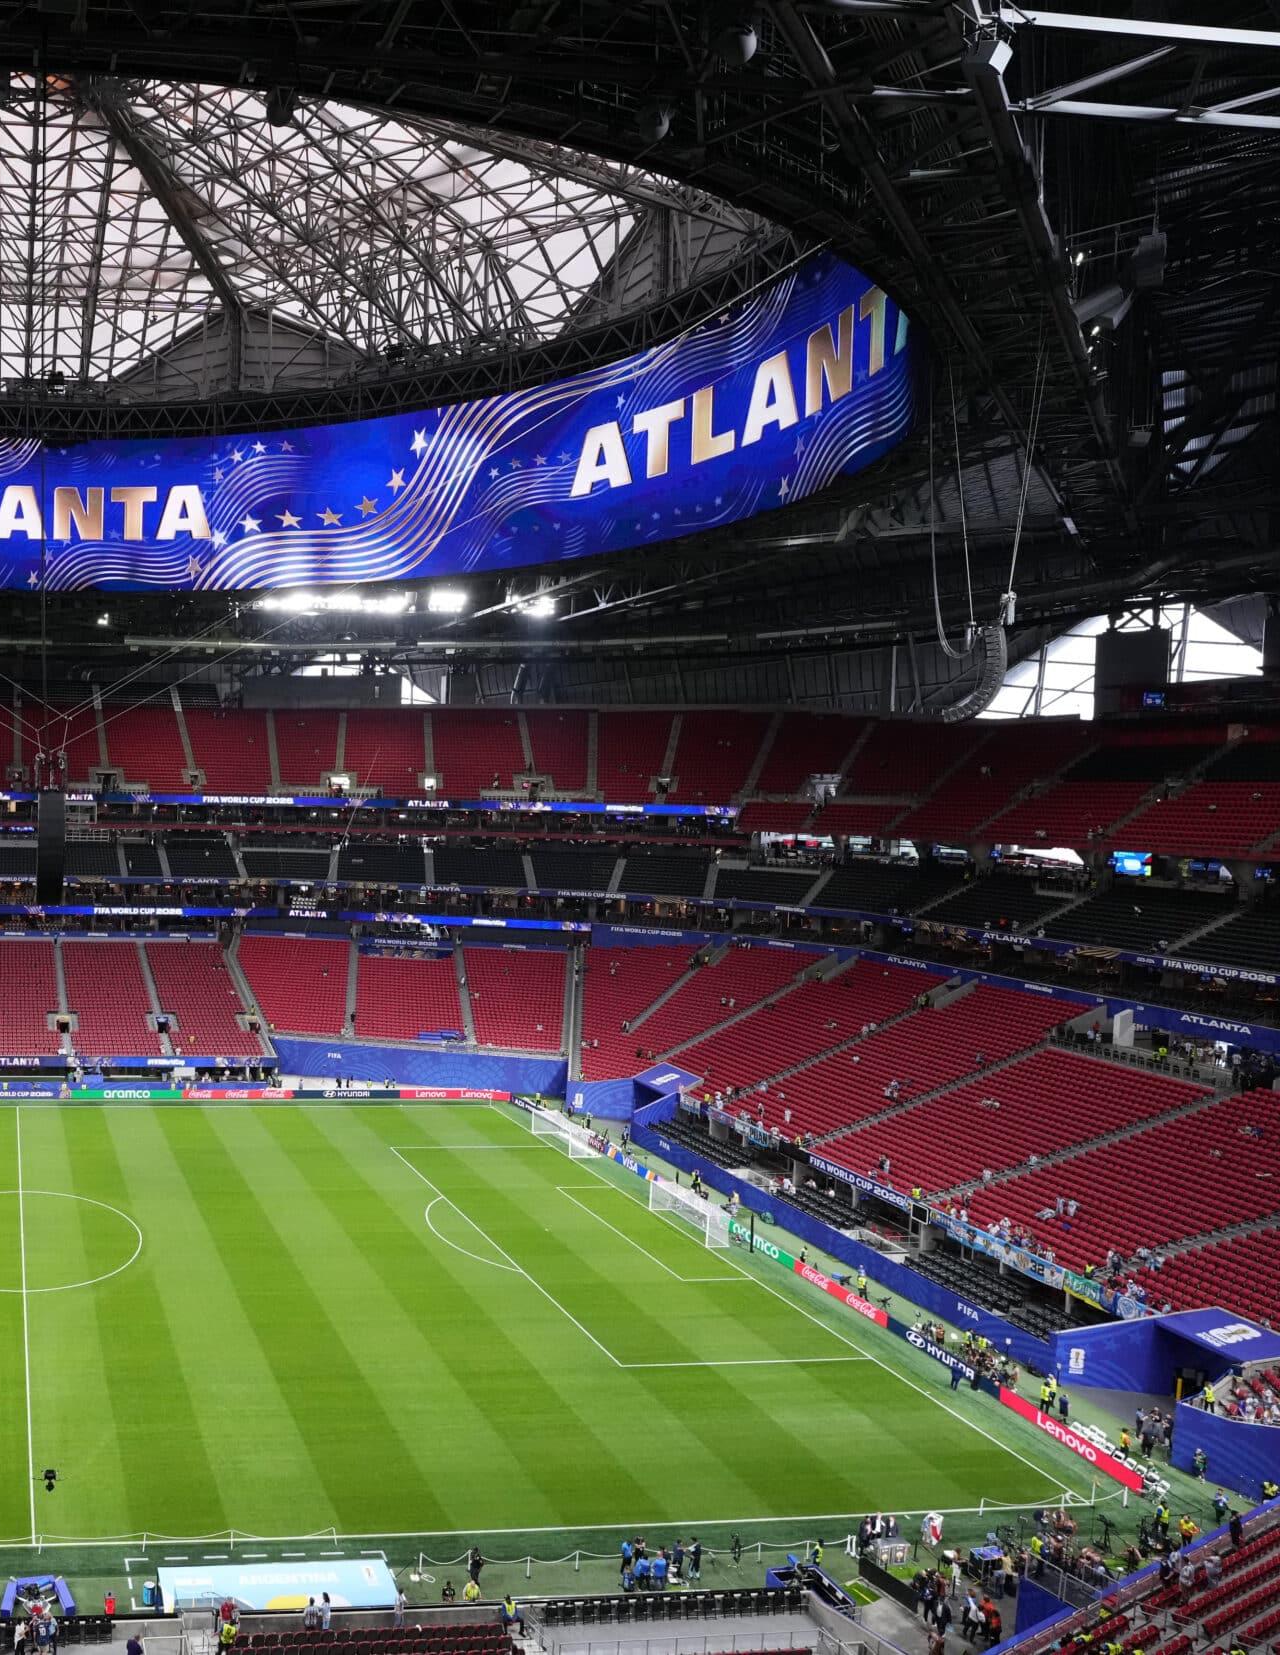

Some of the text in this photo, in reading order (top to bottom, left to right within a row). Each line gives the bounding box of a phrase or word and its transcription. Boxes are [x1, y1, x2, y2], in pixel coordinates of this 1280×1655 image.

[220, 796, 249, 804] WORLD
[408, 800, 449, 808] ATLANTA
[94, 907, 109, 915] FIFA
[110, 907, 139, 915] WORLD
[140, 907, 155, 915] CUP
[289, 910, 327, 918] ATLANTA
[982, 932, 1032, 946] ATLANTA
[887, 955, 928, 970] ATLANTA
[1163, 959, 1183, 969] FIFA
[1183, 962, 1218, 974] WORLD
[1218, 967, 1239, 978] CUP
[1239, 971, 1276, 984] 2026
[1180, 1014, 1252, 1036] ATLANTA
[103, 1090, 150, 1098] aramco
[188, 1090, 212, 1099] Coca-Cola
[225, 1090, 248, 1099] Coca-Cola
[261, 1090, 285, 1099] Coca-Cola
[415, 1090, 447, 1098] Lenovo
[460, 1090, 493, 1099] Lenovo
[621, 1155, 639, 1174] VISA
[809, 1156, 905, 1206] FIFA WORLD CUP 2026
[732, 1222, 780, 1259] aramco
[1030, 1260, 1045, 1276] 32
[801, 1265, 828, 1290] Coca-Cola
[846, 1293, 876, 1320] Coca-Cola
[957, 1302, 979, 1321] FIFA
[1036, 1411, 1097, 1462] Lenovo
[239, 1572, 339, 1586] ARGENTINA
